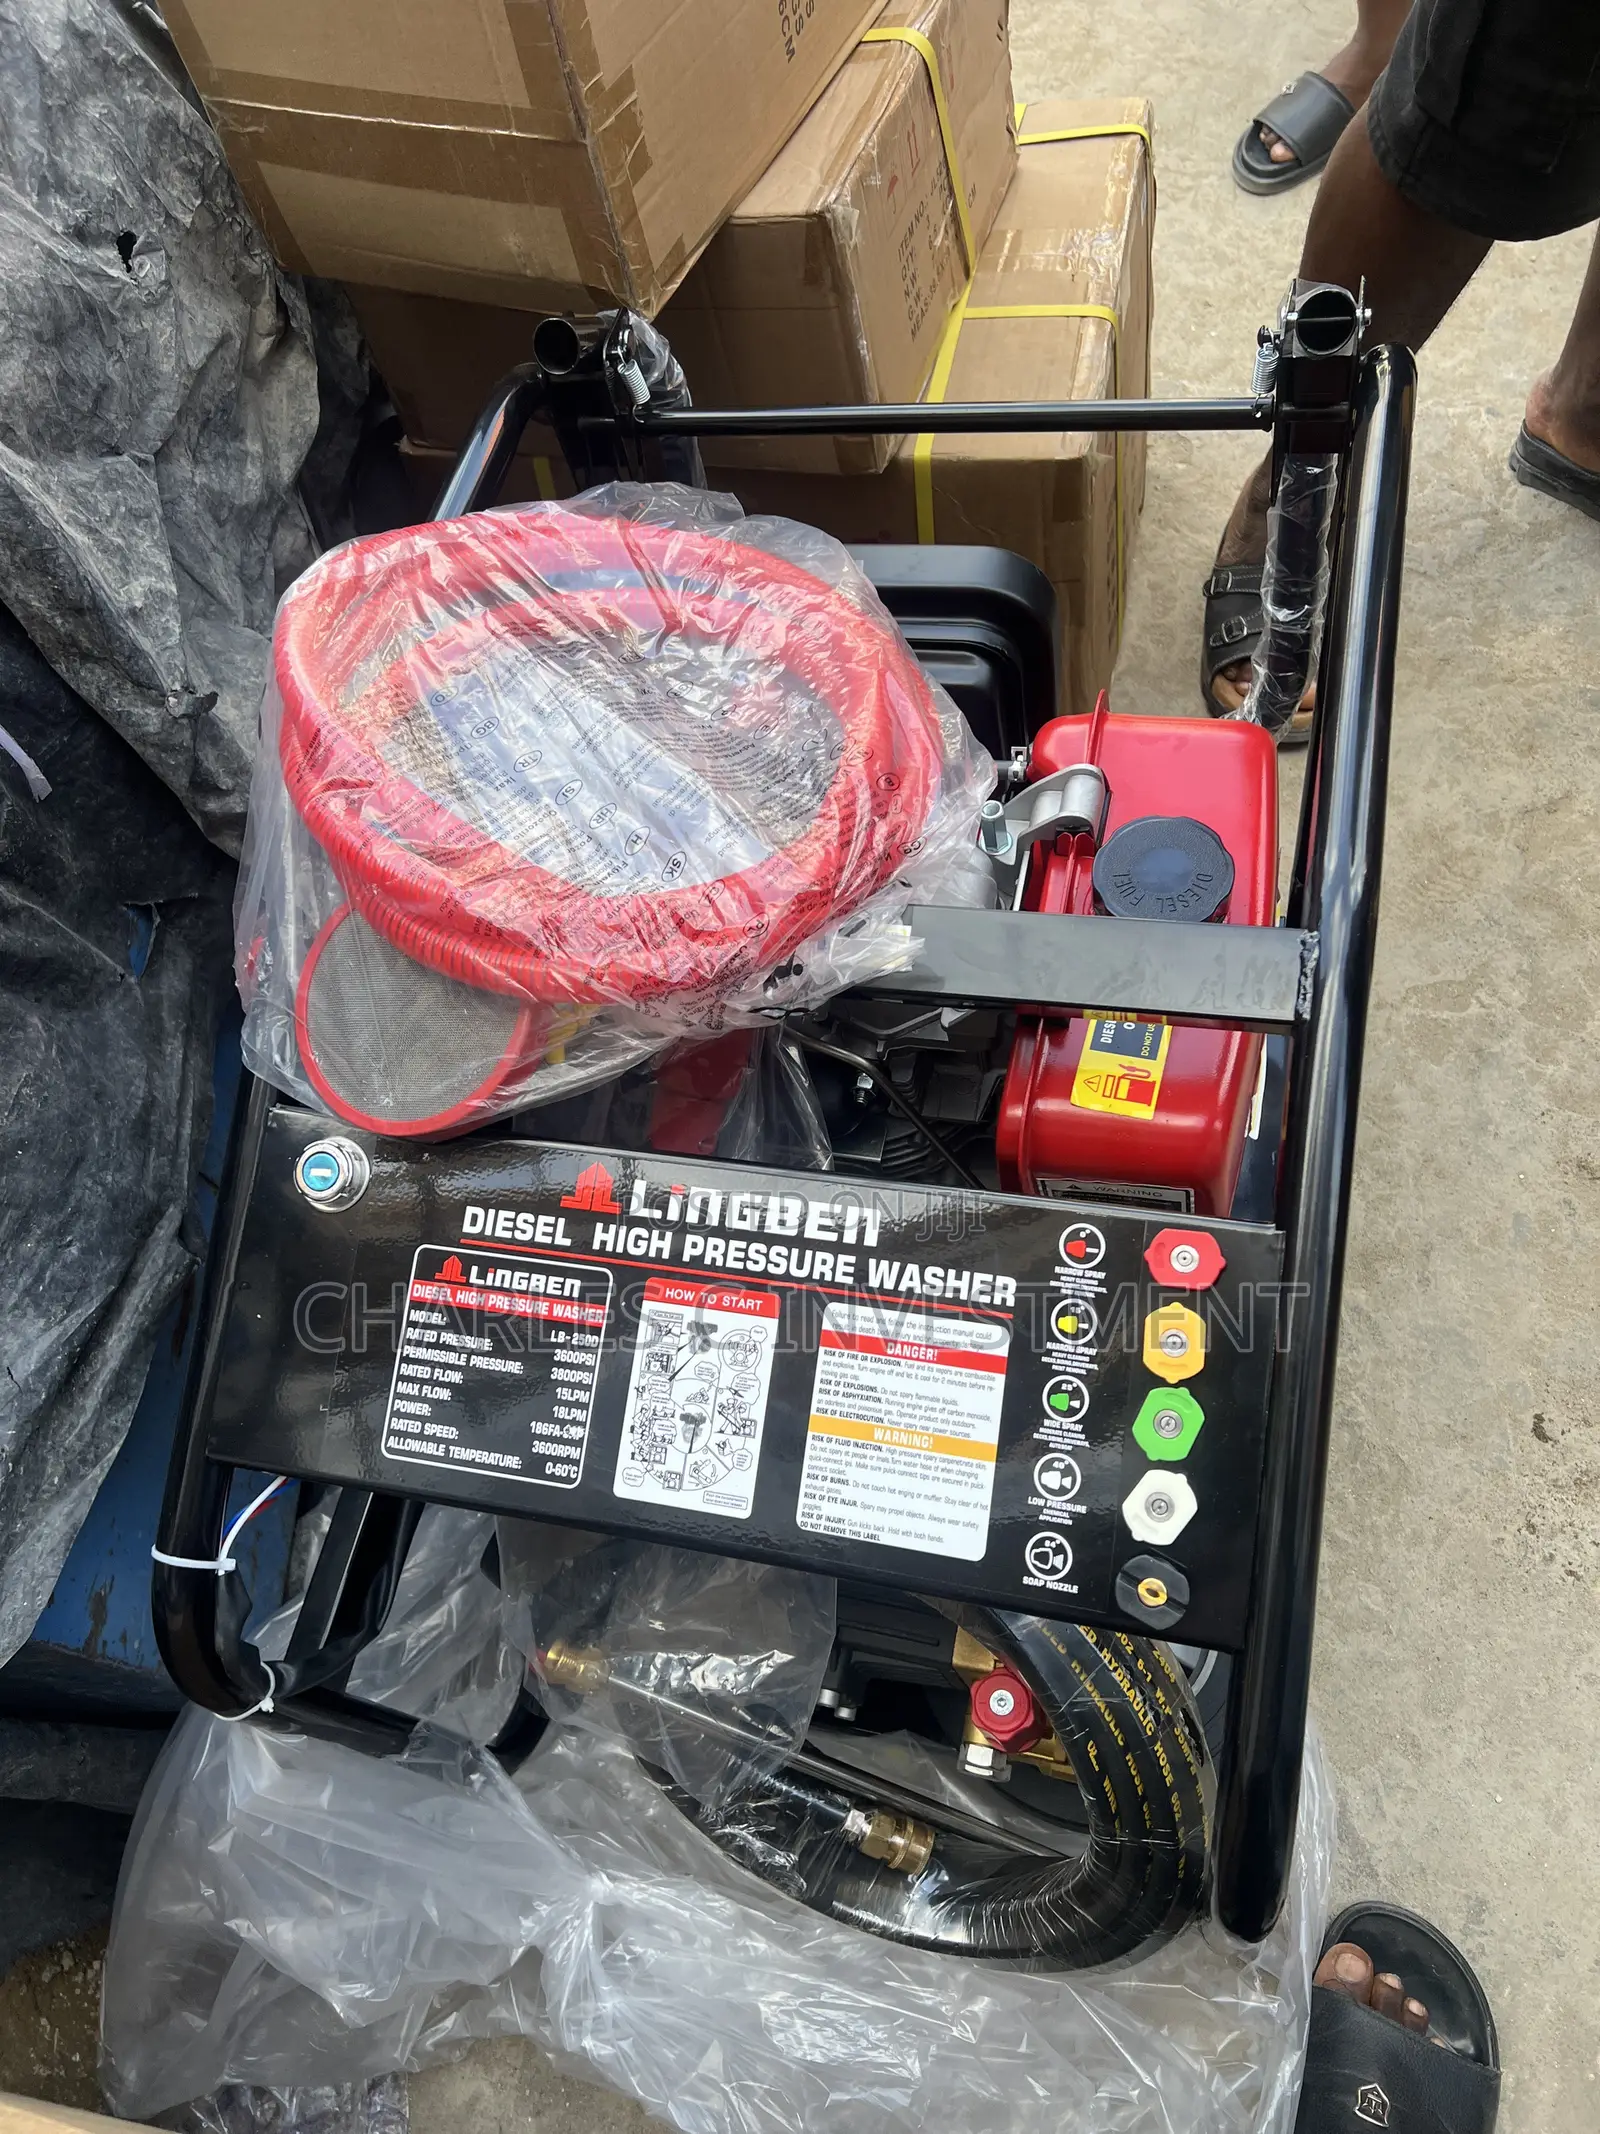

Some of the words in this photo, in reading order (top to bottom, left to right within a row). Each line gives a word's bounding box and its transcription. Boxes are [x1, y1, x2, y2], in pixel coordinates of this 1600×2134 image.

[665, 856, 683, 879] SK
[1155, 873, 1214, 913] DIESEL
[1143, 1031, 1154, 1047] NOT
[1093, 1185, 1164, 1198] WARNING
[462, 1205, 574, 1246] DIESEL
[592, 1219, 673, 1259] HIGH
[682, 1233, 856, 1284] PRESSURE
[865, 1257, 1018, 1309] WASHER
[1084, 1269, 1106, 1280] SPRAY
[412, 1282, 454, 1303] DIESEL
[455, 1288, 486, 1308] HIGH
[487, 1293, 549, 1317] PRESSURE
[551, 1302, 604, 1325] WASHER
[664, 1286, 695, 1302] HOW
[698, 1290, 717, 1305] TO
[722, 1294, 763, 1311] START
[407, 1307, 449, 1326] MODEL:
[548, 1327, 600, 1350] LB-250D
[405, 1326, 437, 1344] RATED
[439, 1331, 493, 1351] PRESSURE:
[551, 1347, 597, 1366] 3600PSI
[823, 1348, 836, 1357] RISK
[837, 1350, 845, 1358] OF
[846, 1352, 859, 1360] FIRE
[860, 1354, 868, 1362] OR
[885, 1341, 939, 1362] DANGER!
[1075, 1345, 1097, 1356] SPRAY
[402, 1344, 467, 1366] PERMISSIBLE
[469, 1354, 524, 1374] PRESSURE:
[548, 1366, 593, 1385] 3800PSI
[399, 1362, 431, 1379] RATED
[433, 1367, 463, 1384] FLOW:
[552, 1386, 590, 1403] 15LPM
[818, 1387, 831, 1396] RISK
[832, 1389, 840, 1397] OF
[819, 1377, 832, 1386] RISK
[833, 1379, 841, 1387] OF
[392, 1398, 433, 1416] POWER:
[396, 1380, 419, 1395] MAX
[421, 1384, 451, 1401] FLOW:
[550, 1404, 587, 1422] 18LPM
[815, 1406, 829, 1415] RISK
[829, 1408, 837, 1416] OF
[1061, 1420, 1083, 1432] SPRAY
[390, 1417, 422, 1433] RATED
[423, 1422, 459, 1439] SPEED:
[529, 1439, 581, 1459] 3600RPM
[811, 1433, 824, 1442] RISK
[825, 1436, 833, 1444] OF
[834, 1437, 851, 1447] FLUID
[872, 1427, 935, 1449] WARNING!
[386, 1435, 445, 1456] ALLOWABLE
[447, 1445, 522, 1469] TEMPERATURE:
[806, 1472, 819, 1481] RISK
[820, 1474, 828, 1482] OF
[803, 1491, 817, 1500] RISK
[817, 1493, 826, 1502] OF
[826, 1495, 838, 1504] EYE
[1027, 1496, 1045, 1506] LOW
[1046, 1498, 1087, 1513] PRESSURE
[800, 1511, 814, 1520] RISK
[815, 1513, 823, 1521] OF
[798, 1520, 808, 1529] DO
[809, 1522, 821, 1530] NOT
[822, 1524, 846, 1535] REMOVE
[848, 1528, 861, 1538] THIS
[862, 1531, 881, 1541] LABEL
[1022, 1575, 1045, 1587] SOAP
[1044, 1578, 1078, 1593] NOZZLE
[1070, 1659, 1125, 1747] HYDRAULIC
[1100, 1647, 1155, 1737] HYDRAULIC
[1153, 1740, 1175, 1788] HOSE
